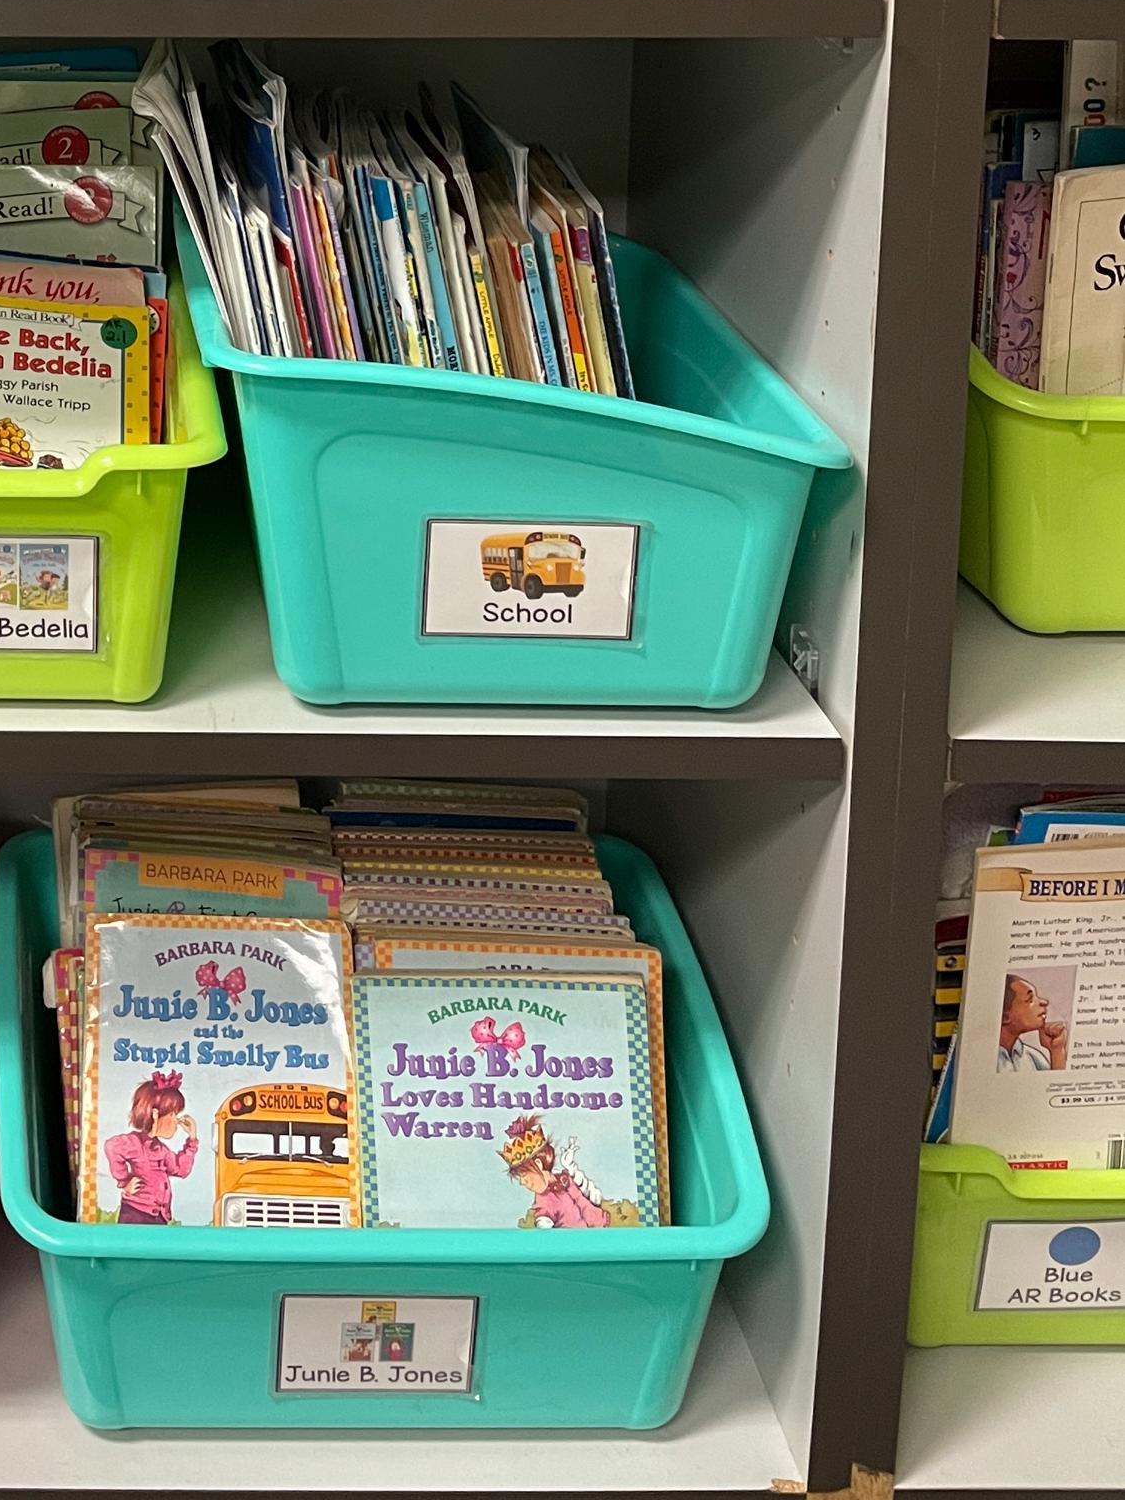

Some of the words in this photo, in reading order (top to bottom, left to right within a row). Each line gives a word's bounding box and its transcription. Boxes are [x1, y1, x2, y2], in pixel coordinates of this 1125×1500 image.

[58, 137, 74, 160] 2
[44, 279, 101, 305] you,
[10, 308, 38, 321] Read
[479, 290, 489, 315] LITTLE
[484, 315, 494, 339] APPLE
[563, 294, 572, 316] APPLE
[18, 327, 90, 357] Back,
[12, 351, 112, 379] Bedelia
[21, 379, 59, 393] Parish
[3, 394, 53, 408] Wallace
[58, 398, 91, 412] Tripp
[483, 602, 572, 623] School
[145, 862, 227, 883] BARBARA
[232, 870, 278, 889] PARK
[1029, 880, 1098, 896] BEFORE
[1102, 880, 1110, 896] I
[154, 940, 237, 968] BARBARA
[240, 943, 288, 972] PARK
[113, 984, 198, 1022] Junie
[206, 987, 238, 1023] B.
[245, 988, 328, 1027] Jones
[426, 997, 513, 1025] BARBARA
[518, 999, 568, 1027] PARK
[193, 1024, 219, 1039] and
[221, 1024, 244, 1040] the
[113, 1038, 191, 1068] Stupid
[196, 1041, 280, 1072] Smelly
[283, 1044, 330, 1070] Bus
[387, 1042, 476, 1080] Junie
[484, 1043, 519, 1079] B.
[525, 1044, 614, 1081] Jones
[258, 1093, 302, 1110] SCHOOL
[303, 1095, 323, 1110] BUS
[380, 1081, 464, 1108] Loves
[468, 1082, 624, 1111] Handsome
[380, 1111, 495, 1140] Warren
[1044, 1267, 1093, 1283] Blue
[1007, 1288, 1041, 1304] AR
[1049, 1287, 1122, 1304] Books
[285, 1365, 350, 1382] Junie
[360, 1366, 378, 1383] B.
[388, 1365, 463, 1383] Jones
